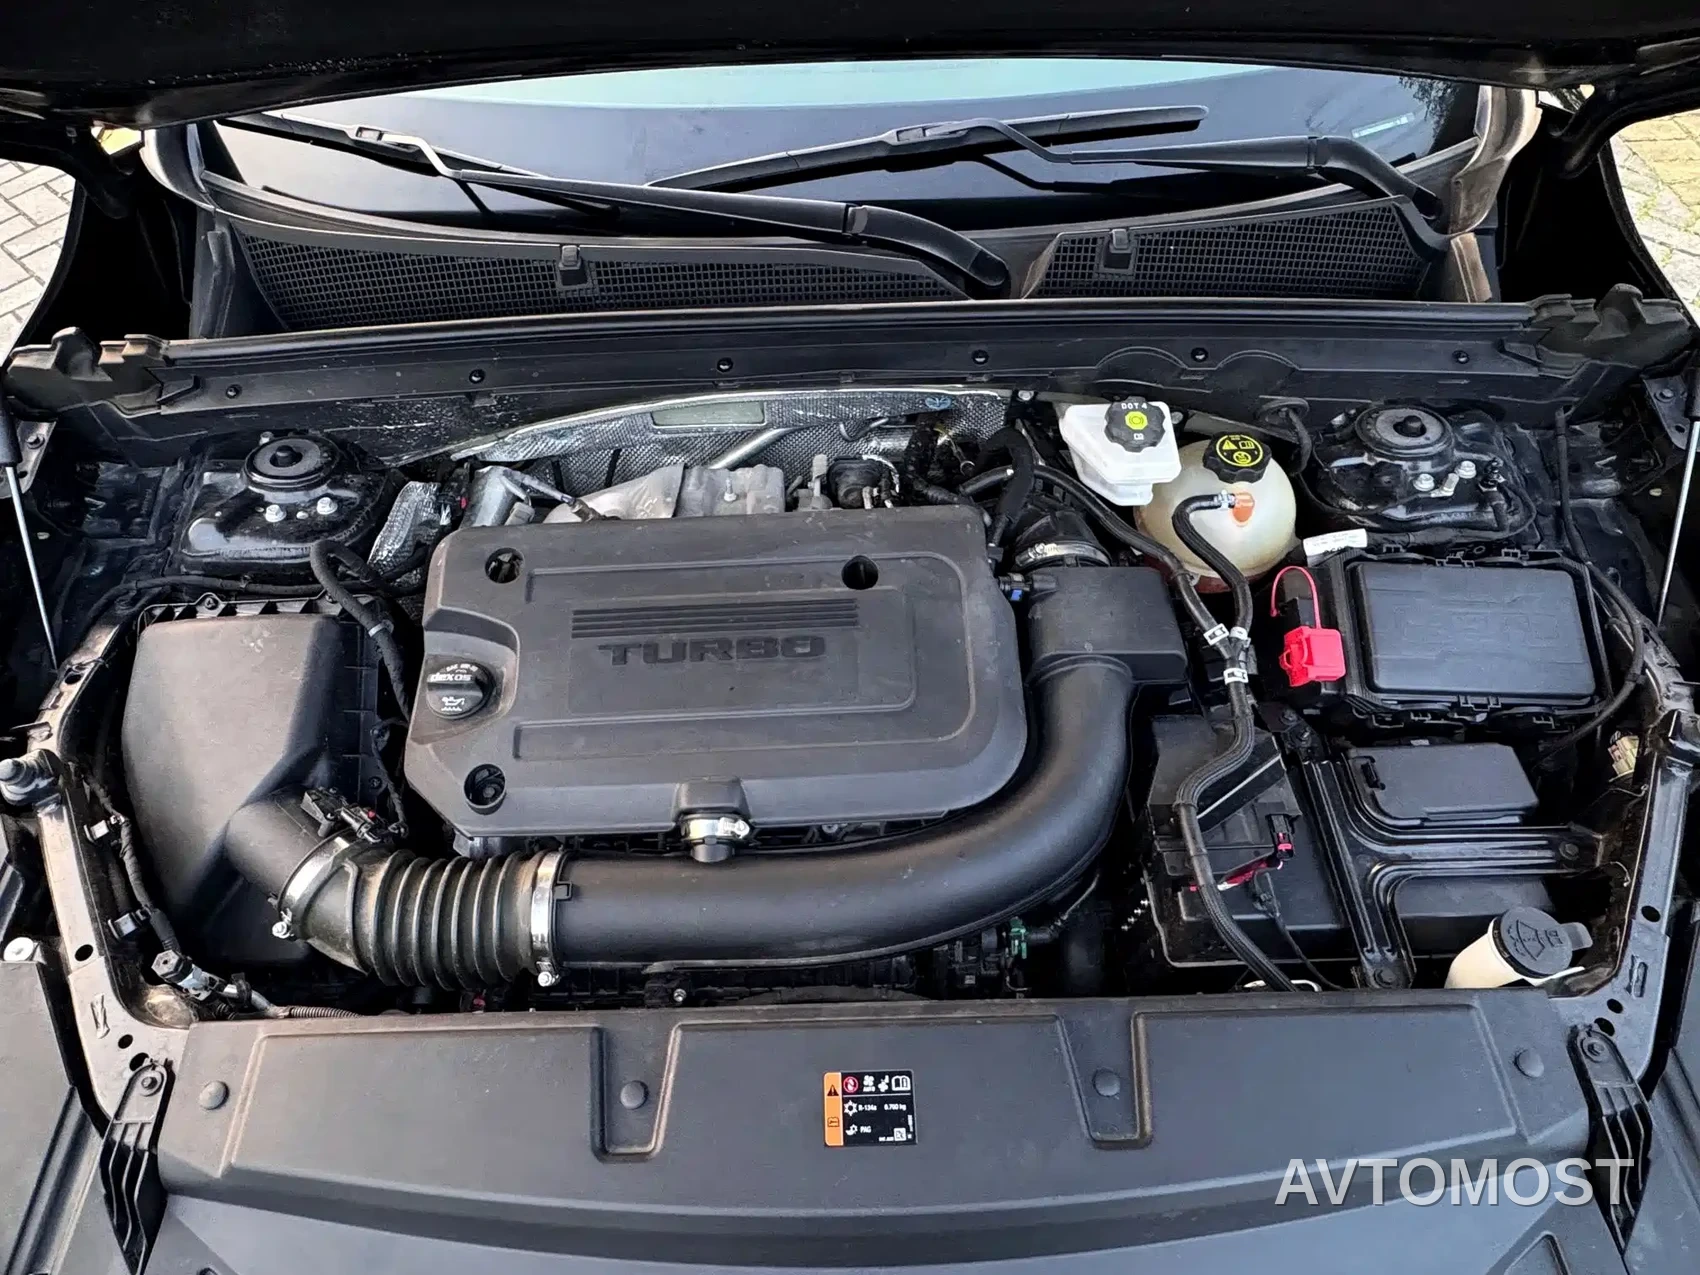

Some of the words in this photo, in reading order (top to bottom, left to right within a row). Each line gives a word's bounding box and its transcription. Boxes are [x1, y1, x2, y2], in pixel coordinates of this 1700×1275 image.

[1121, 402, 1139, 410] DOT
[1141, 402, 1148, 410] 4
[598, 635, 826, 666] TURBO
[430, 672, 472, 682] dexos
